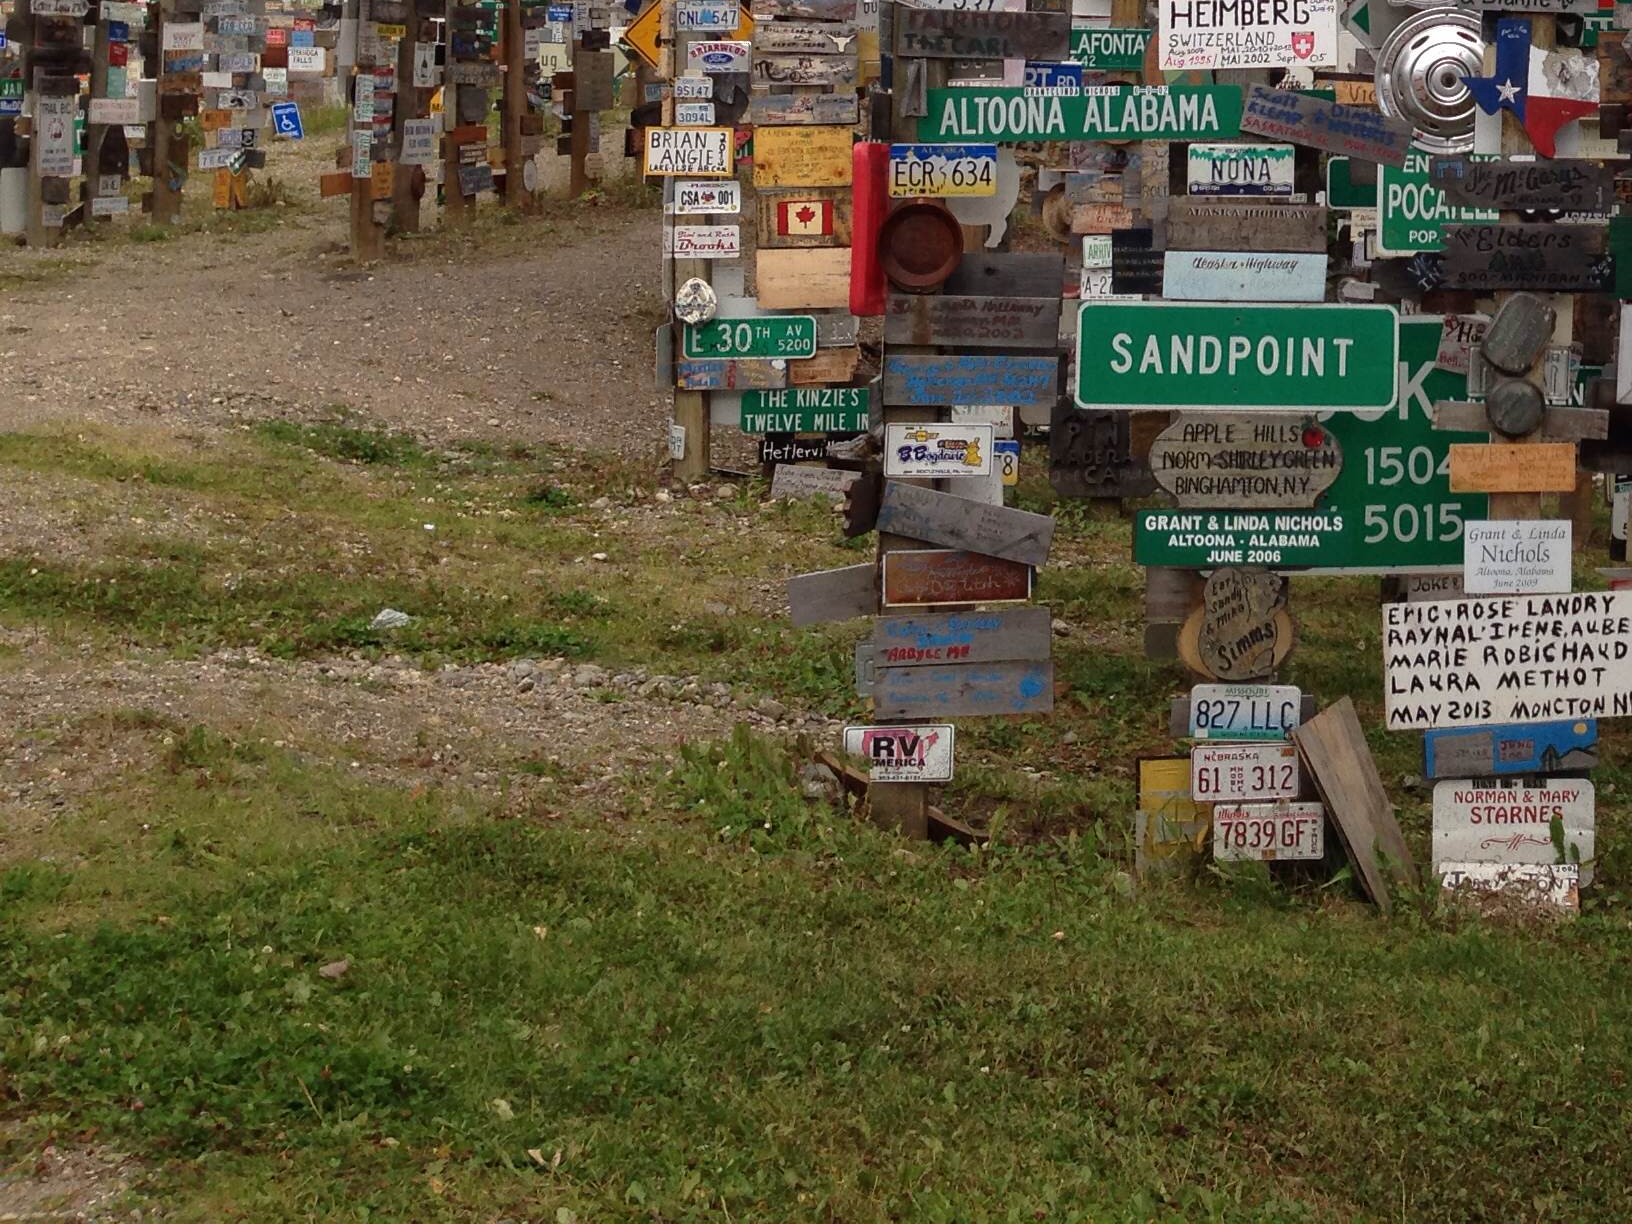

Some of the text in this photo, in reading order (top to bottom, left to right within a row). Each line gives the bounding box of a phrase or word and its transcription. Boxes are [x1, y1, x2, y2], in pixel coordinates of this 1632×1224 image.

[678, 10, 737, 25] CNL 547
[1168, 31, 1276, 48] SWITZERLAND
[939, 97, 1066, 136] ALTOONA
[1083, 95, 1219, 133] ALABAMA
[651, 132, 707, 149] BRIAN
[660, 149, 713, 166] ANGIE
[894, 160, 992, 187] ECR 634
[1211, 157, 1271, 183] NONA
[681, 190, 734, 205] CSA 001
[778, 338, 811, 352] 5200
[1110, 332, 1354, 376] SANDPOINT
[758, 388, 860, 408] THE KINZIE'S
[744, 414, 804, 433] TWELVE
[1183, 425, 1298, 443] APPLE HILLS
[1145, 515, 1343, 531] GRANT LINDA NICHOLS
[1364, 503, 1464, 543] 5015
[1168, 534, 1320, 547] ALTOONA ALABAMA
[1468, 528, 1507, 544] Grant
[1206, 550, 1281, 563] JUNE 2006
[1480, 542, 1551, 564] Nichols
[1527, 595, 1616, 617] LANDRY
[1496, 667, 1607, 689] METHOT
[1196, 700, 1241, 729] 827
[1390, 703, 1443, 725] MAY
[1447, 699, 1493, 720] 2013
[873, 736, 919, 757] RV
[1204, 752, 1259, 762] NEBRASKA
[1197, 765, 1294, 794] 61 312
[1453, 789, 1580, 804] NORMAN MARY
[1470, 805, 1563, 824] STARNES
